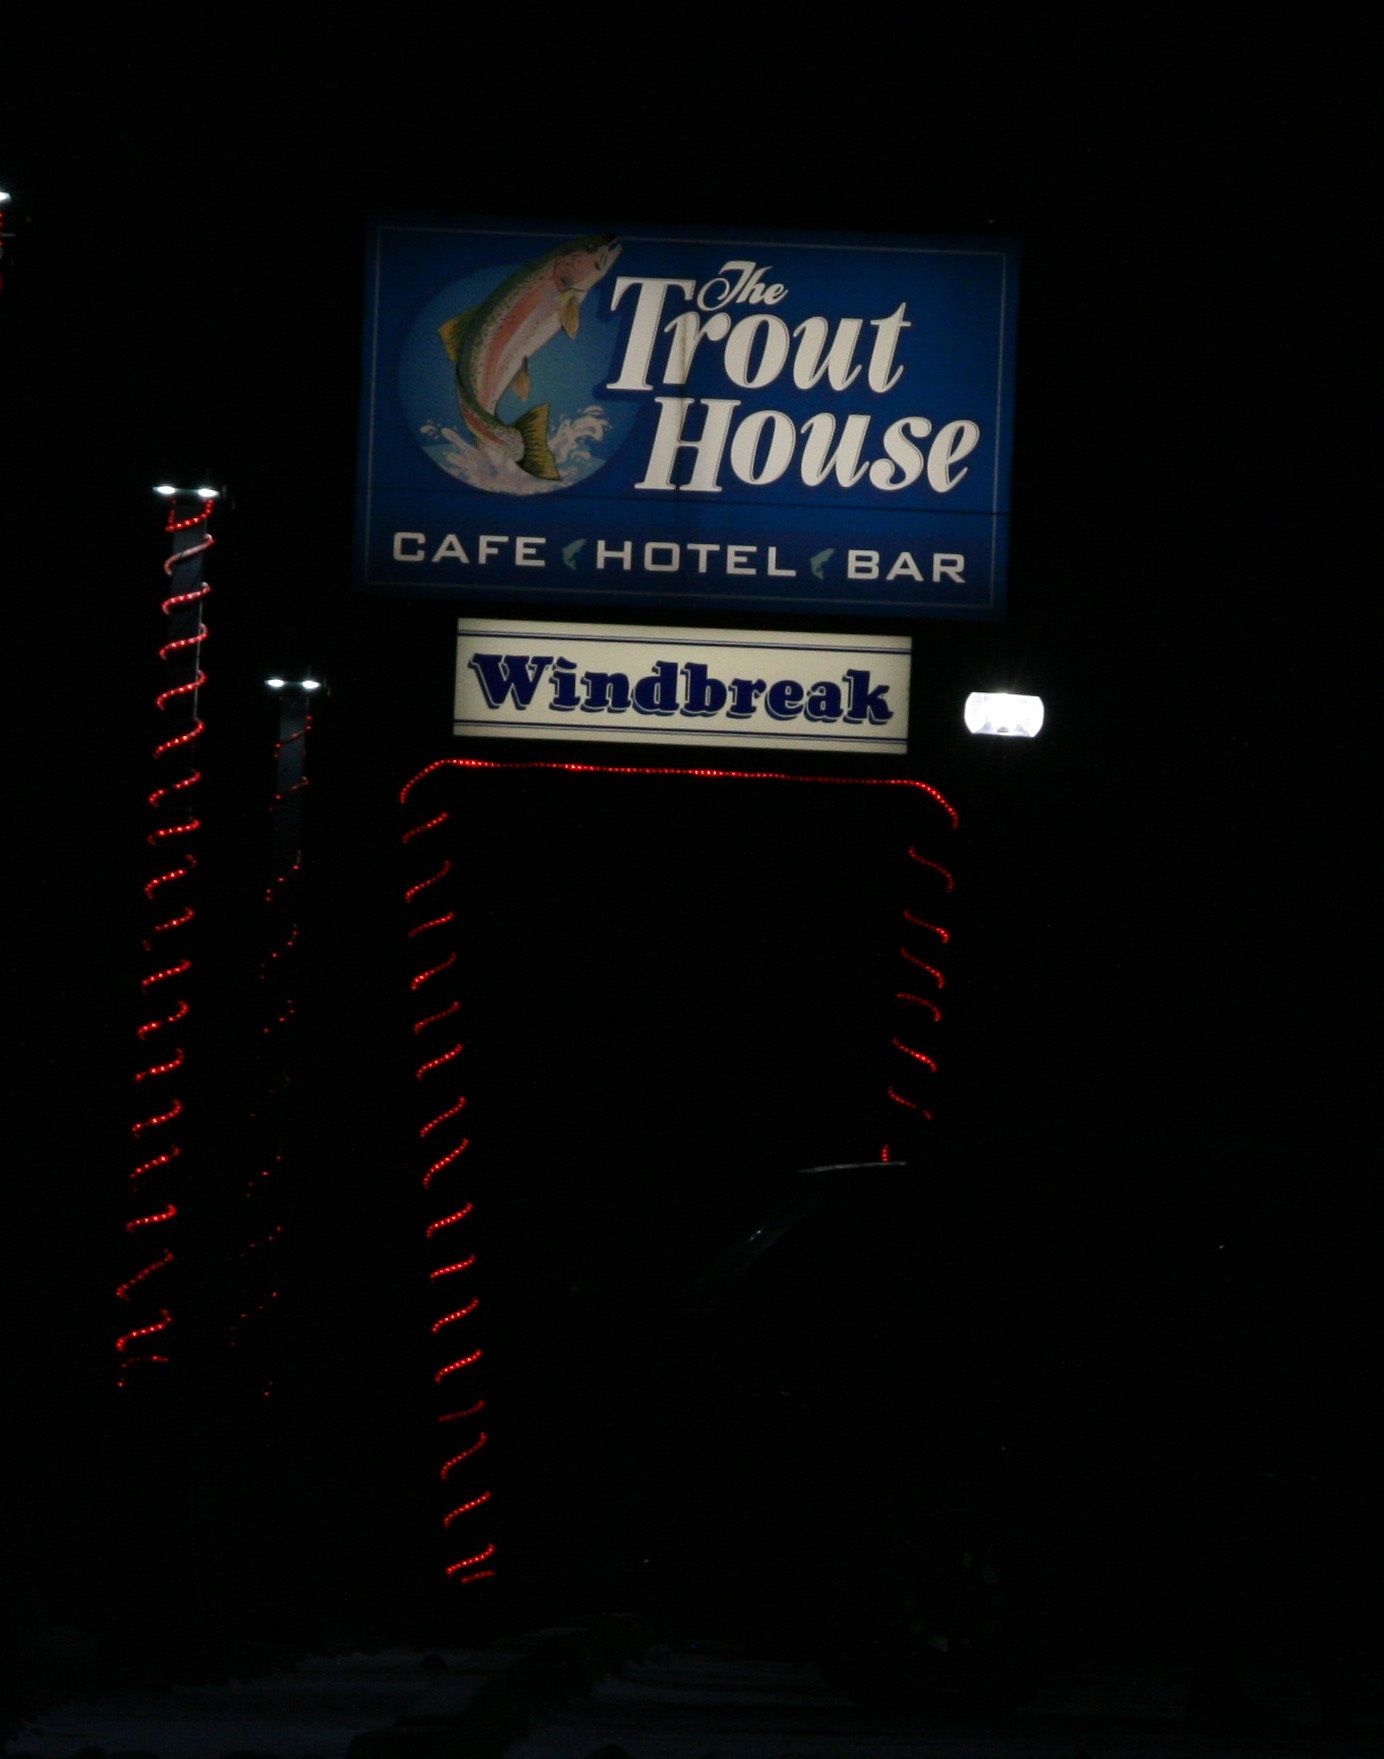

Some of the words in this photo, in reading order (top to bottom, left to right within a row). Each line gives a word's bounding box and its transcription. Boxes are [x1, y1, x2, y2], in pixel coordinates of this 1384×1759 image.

[697, 260, 788, 311] The
[606, 275, 911, 393] Trout
[634, 396, 980, 493] House
[392, 531, 547, 567] CAFE
[596, 539, 796, 578] HOTEL
[847, 549, 966, 584] BAR
[467, 652, 893, 725] Windbreak
